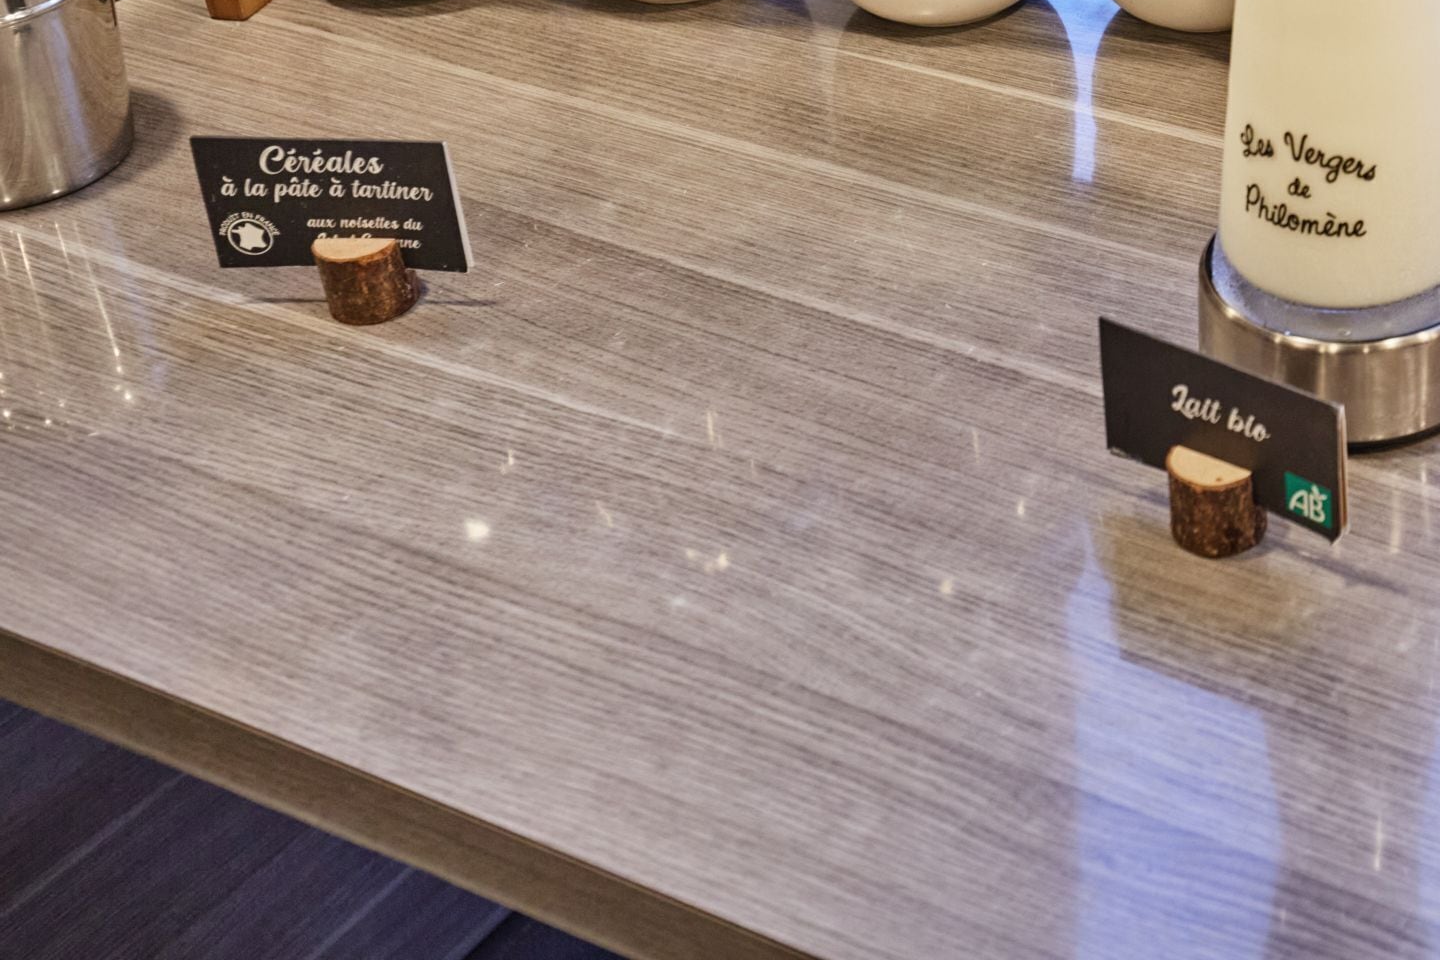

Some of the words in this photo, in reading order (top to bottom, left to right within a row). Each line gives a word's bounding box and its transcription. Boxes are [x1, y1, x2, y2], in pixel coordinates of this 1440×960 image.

[259, 145, 384, 175] Céréales
[1241, 124, 1274, 157] Les
[1284, 131, 1376, 183] Vergers
[220, 176, 237, 197] à
[244, 178, 268, 197] la
[274, 178, 322, 203] pâte
[329, 177, 345, 198] à
[352, 179, 434, 201] tartiner
[1288, 178, 1311, 199] de
[307, 218, 336, 228] aux
[340, 217, 400, 229] noisettes
[403, 218, 424, 230] du
[1246, 184, 1367, 237] Philomène
[1171, 384, 1222, 423] Lait
[1227, 407, 1272, 442] bio
[1288, 484, 1328, 523] AB
